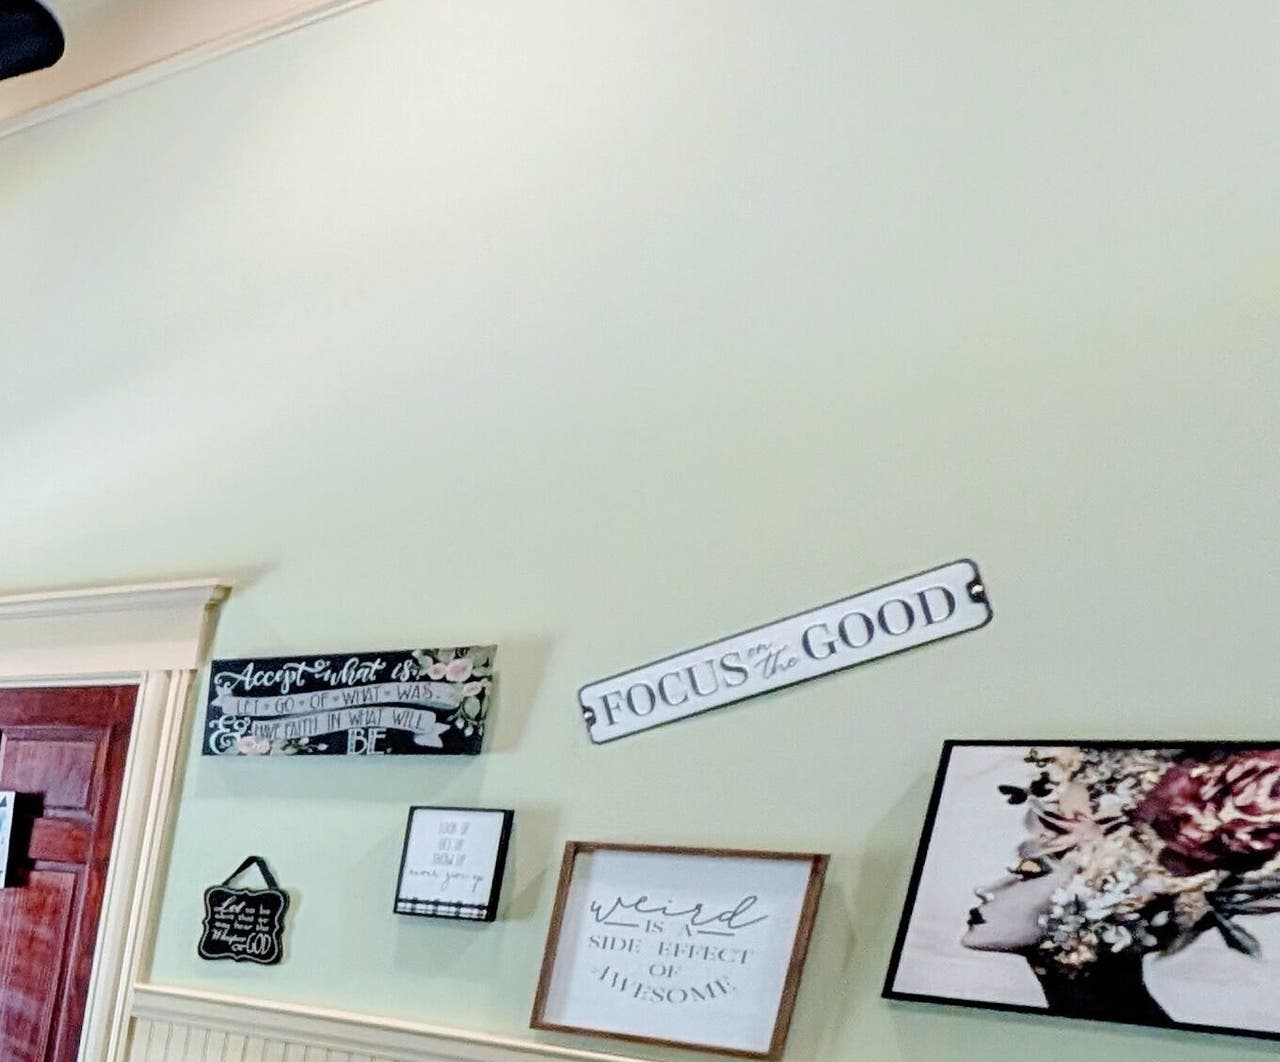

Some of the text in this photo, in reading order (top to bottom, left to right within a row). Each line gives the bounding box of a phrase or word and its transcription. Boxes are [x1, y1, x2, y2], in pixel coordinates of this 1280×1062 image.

[598, 584, 956, 727] FOCUS on the GOOD
[214, 658, 320, 694] Accept
[318, 657, 387, 687] what
[236, 697, 258, 715] LET
[274, 698, 295, 713] GO
[310, 694, 329, 710] OF
[342, 684, 381, 705] WHAT
[327, 714, 340, 730] IN
[349, 709, 384, 727] WHAT
[392, 710, 425, 730] WILL
[590, 895, 768, 929] weird
[645, 919, 693, 937] IS A
[246, 933, 271, 954] GOD
[589, 936, 754, 965] SIDE EFFECT
[591, 965, 737, 1004] AWESOME
[649, 963, 682, 978] OF
